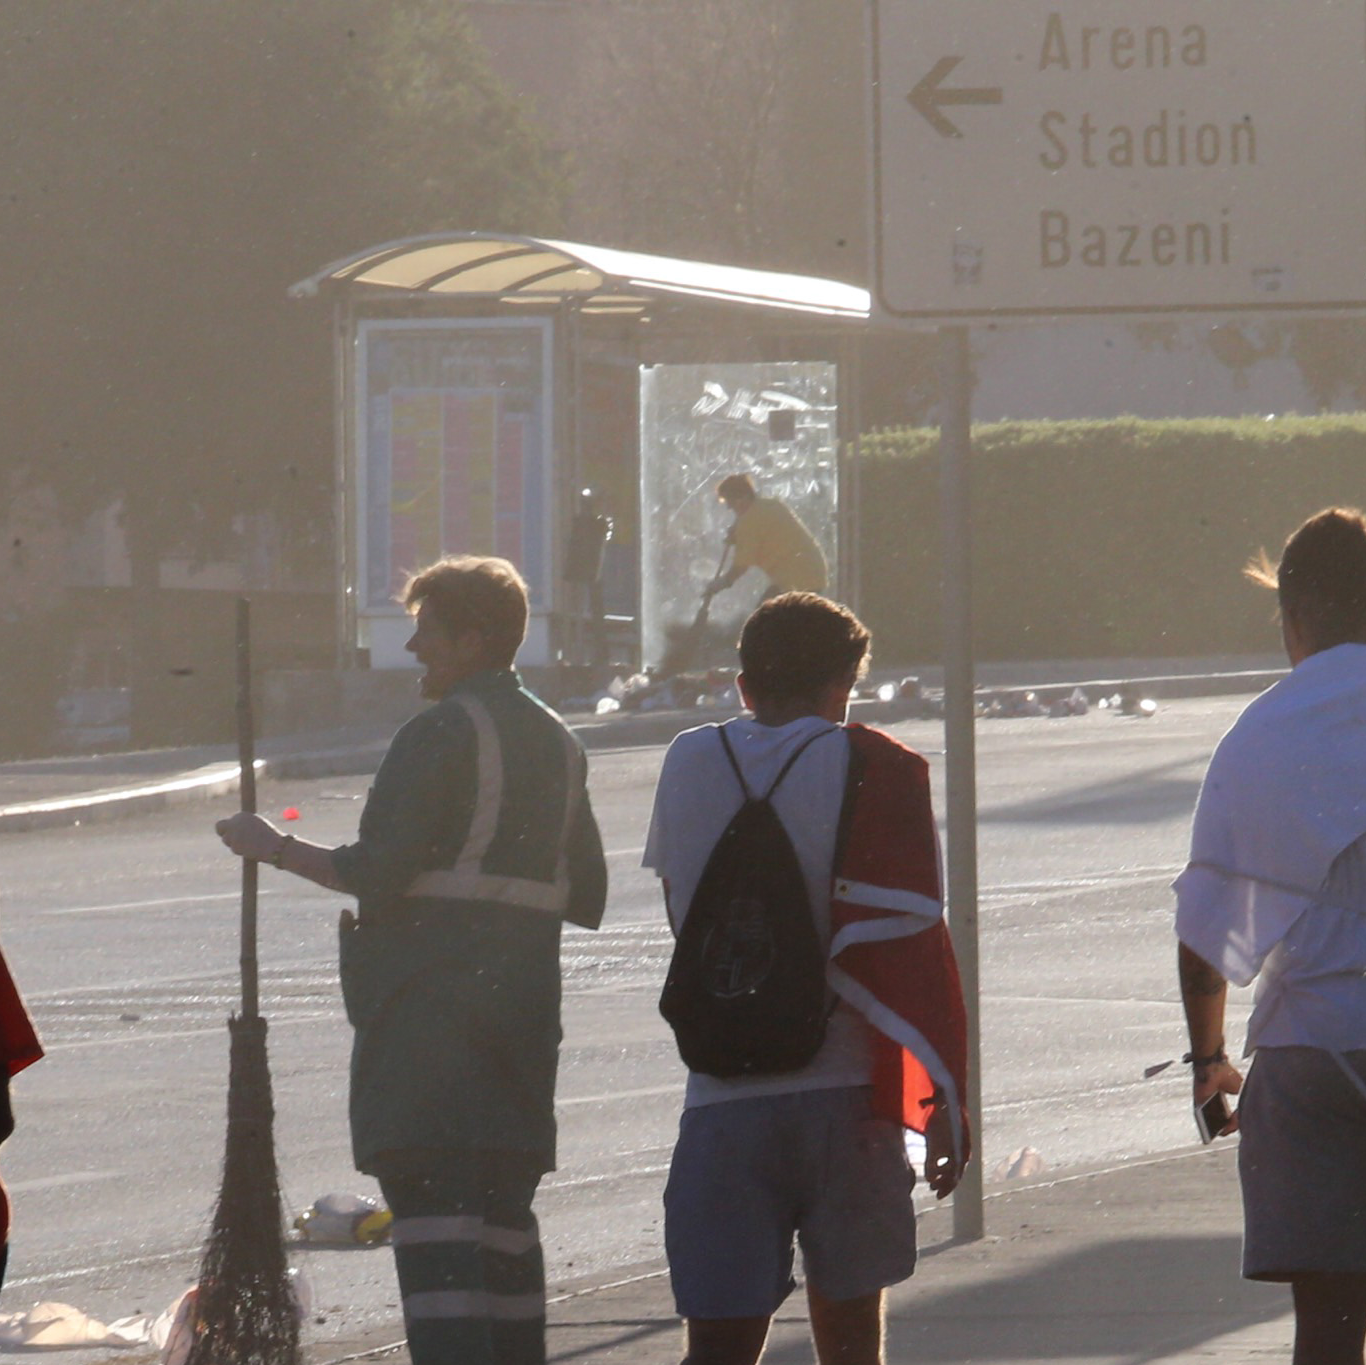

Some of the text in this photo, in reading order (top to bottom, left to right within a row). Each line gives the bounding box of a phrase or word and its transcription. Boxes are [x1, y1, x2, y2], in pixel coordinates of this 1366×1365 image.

[1039, 12, 1208, 71] Arena
[1038, 109, 1257, 171] Stadion
[1039, 206, 1231, 270] Bazeni
